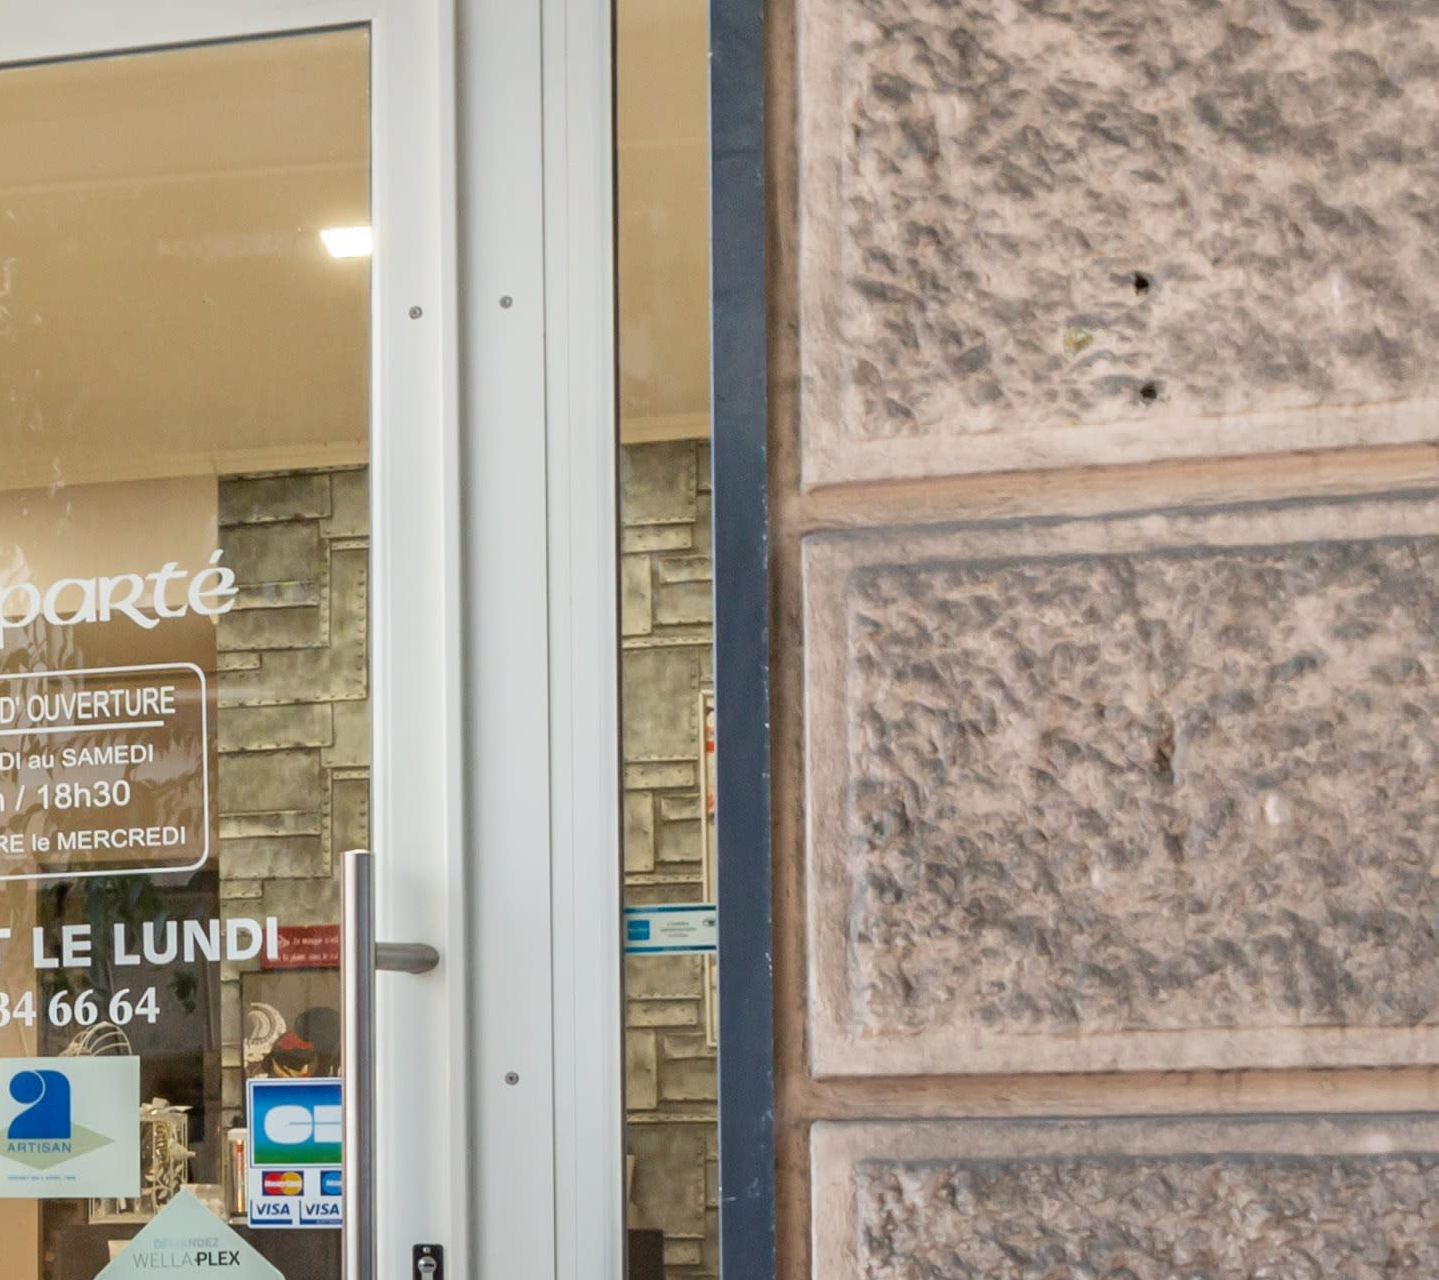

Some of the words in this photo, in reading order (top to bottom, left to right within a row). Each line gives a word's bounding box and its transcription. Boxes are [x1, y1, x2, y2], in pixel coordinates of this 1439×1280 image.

[30, 686, 175, 722] OUVERTURE
[28, 753, 55, 770] au
[62, 744, 154, 766] SAMEDI
[15, 784, 26, 813] /
[37, 780, 131, 811] 18h30
[32, 832, 50, 852] le
[57, 826, 186, 851] MERCREDI
[32, 924, 93, 970] LE
[113, 916, 280, 966] LUNDI
[48, 988, 97, 1026] 66
[108, 986, 161, 1024] 64
[7, 1141, 72, 1154] ARTISAN
[257, 1203, 290, 1216] VISA
[306, 1203, 340, 1216] VISA
